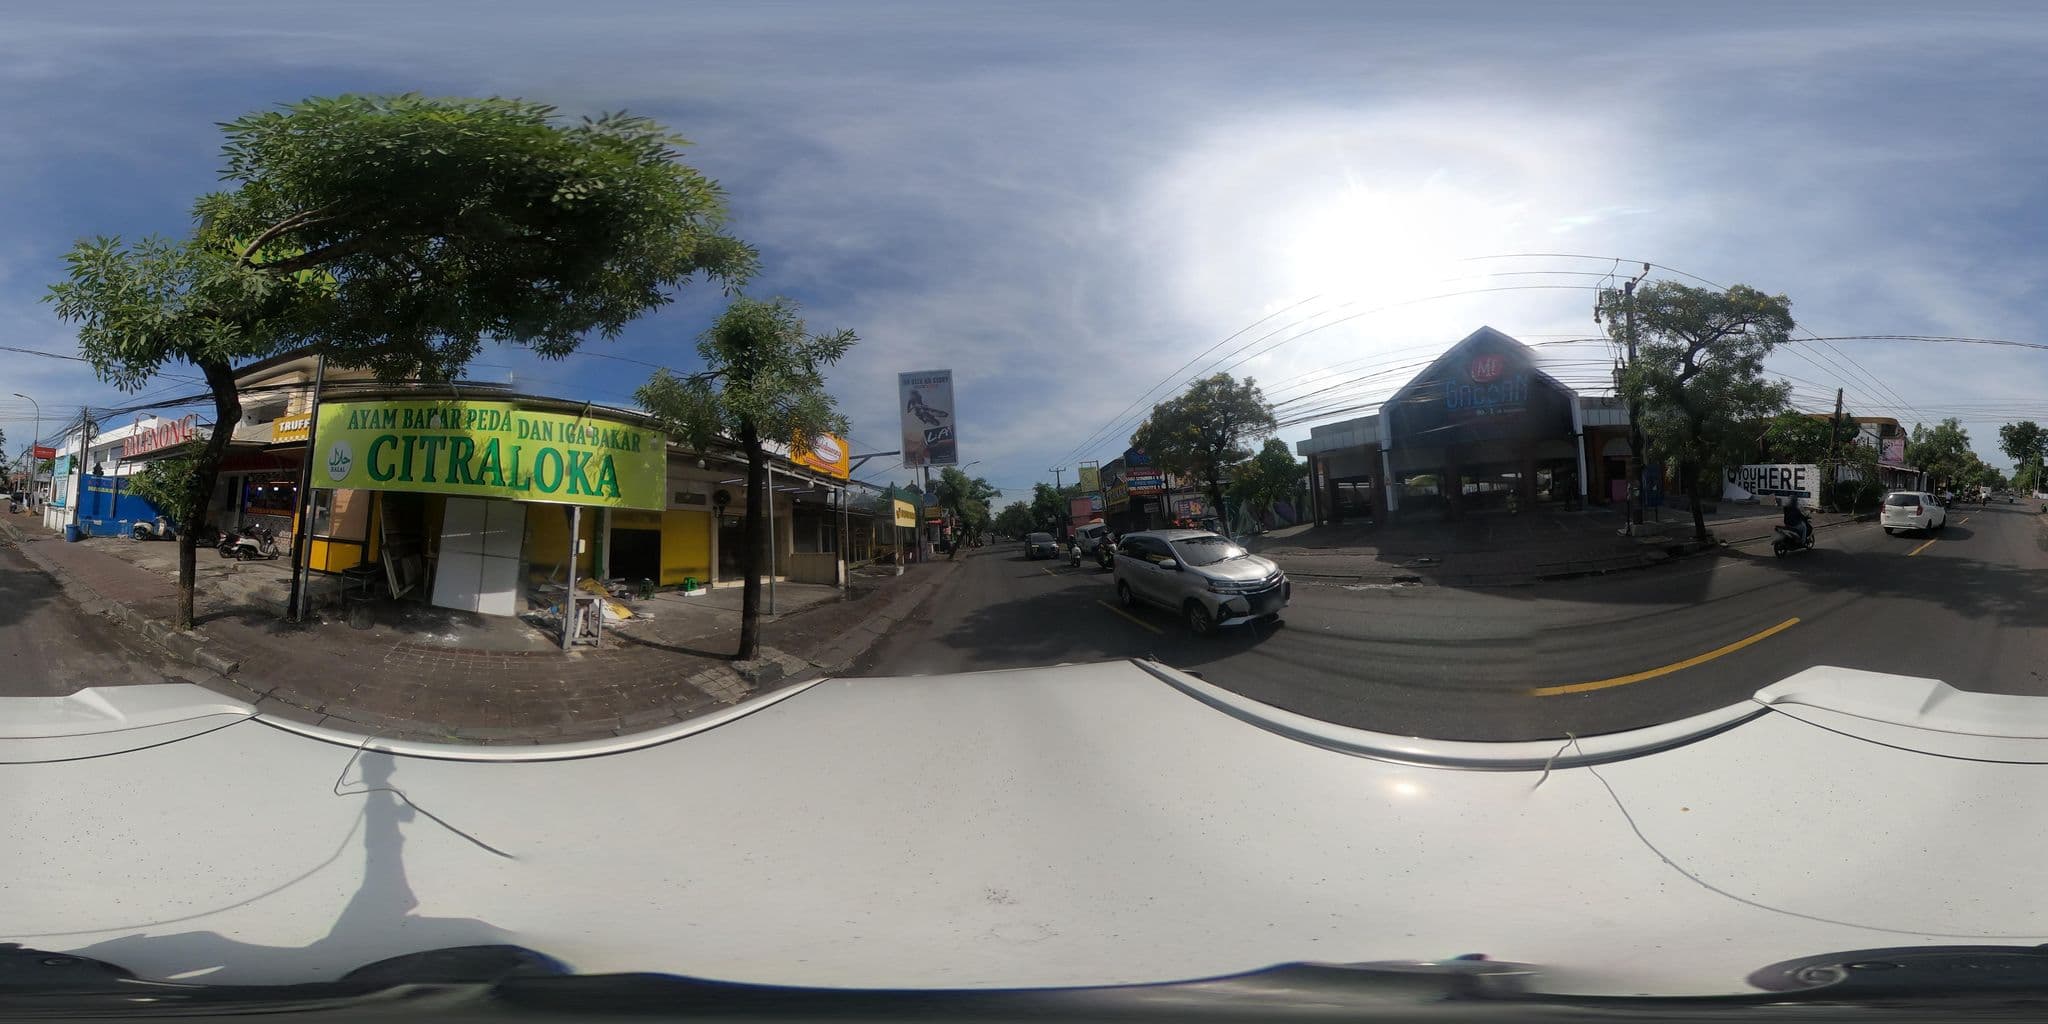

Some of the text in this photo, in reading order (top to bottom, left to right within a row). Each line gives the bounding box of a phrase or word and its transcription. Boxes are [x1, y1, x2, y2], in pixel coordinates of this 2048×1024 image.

[349, 408, 398, 430] AYAM
[517, 418, 553, 442] DAN
[559, 422, 586, 445] IGA
[591, 426, 641, 453] BAKAR
[367, 434, 622, 498] CITRALOKA
[1757, 467, 1806, 490] HERE
